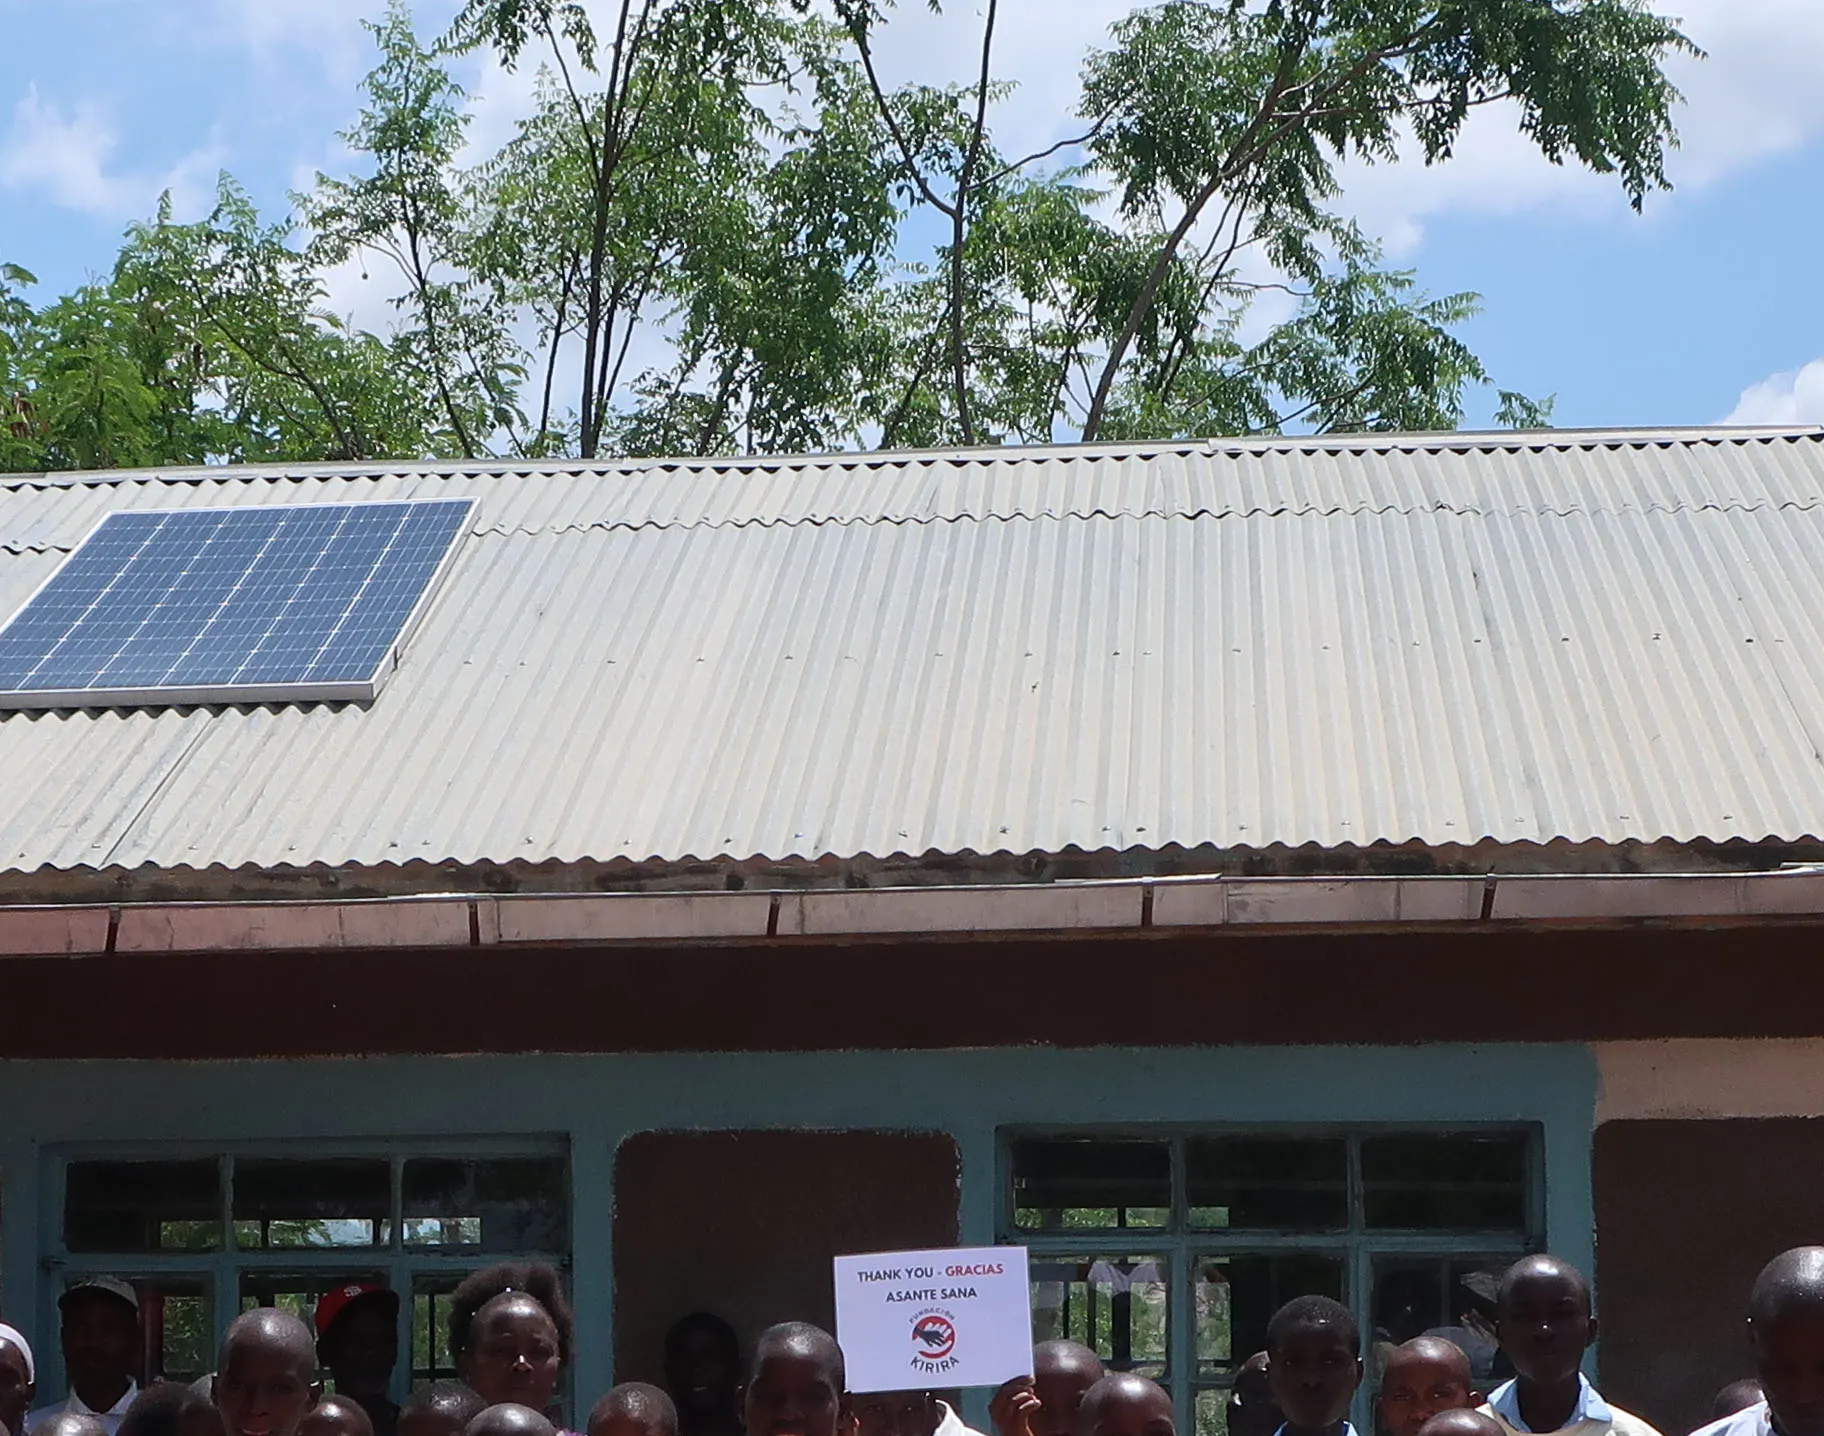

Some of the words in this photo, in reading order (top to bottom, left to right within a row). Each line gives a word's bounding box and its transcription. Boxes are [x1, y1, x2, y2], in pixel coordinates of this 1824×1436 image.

[857, 1268, 901, 1283] THANK
[905, 1267, 934, 1280] YOU
[945, 1263, 1004, 1277] GRACIAS
[886, 1289, 936, 1303] ASANTE
[941, 1287, 978, 1299] SANA
[910, 1355, 960, 1374] KIRIRA
